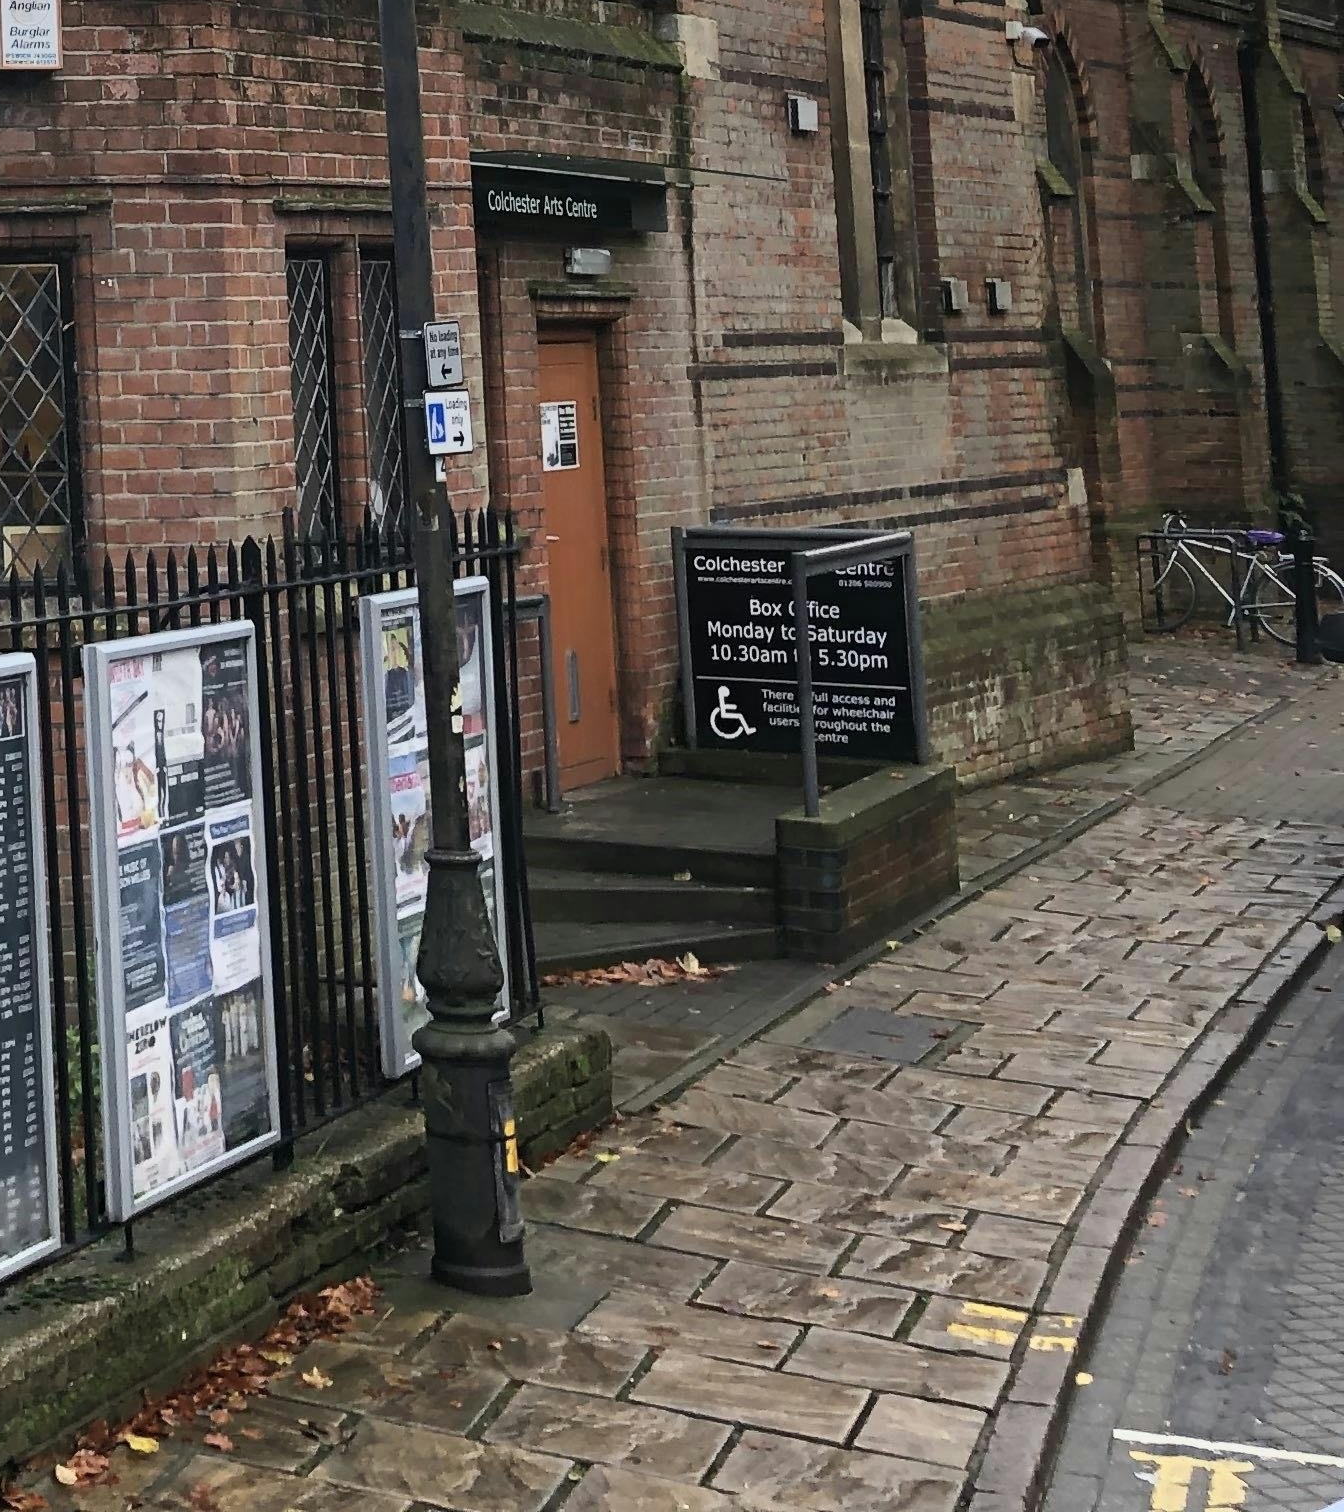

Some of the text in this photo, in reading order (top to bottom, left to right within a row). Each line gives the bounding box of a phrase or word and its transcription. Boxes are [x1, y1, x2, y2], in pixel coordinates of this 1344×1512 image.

[9, 0, 51, 13] Anglian
[9, 26, 51, 39] Burglar
[11, 39, 51, 49] Alarms
[488, 190, 597, 218] Colchester Arts Centre
[438, 330, 458, 343] loading
[446, 398, 467, 411] Loading
[693, 555, 786, 573] Colchester
[697, 576, 793, 585] www.colchesterartscentre.c
[749, 598, 840, 619] Box fice
[707, 620, 888, 649] Monday to Saturday
[710, 644, 788, 664] 10.30am
[818, 648, 888, 672] 5.30pm
[761, 688, 795, 701] There
[832, 693, 871, 706] access
[873, 696, 896, 707] and
[762, 701, 896, 720] faciliti for wheelchair
[769, 717, 892, 734] users roughout the
